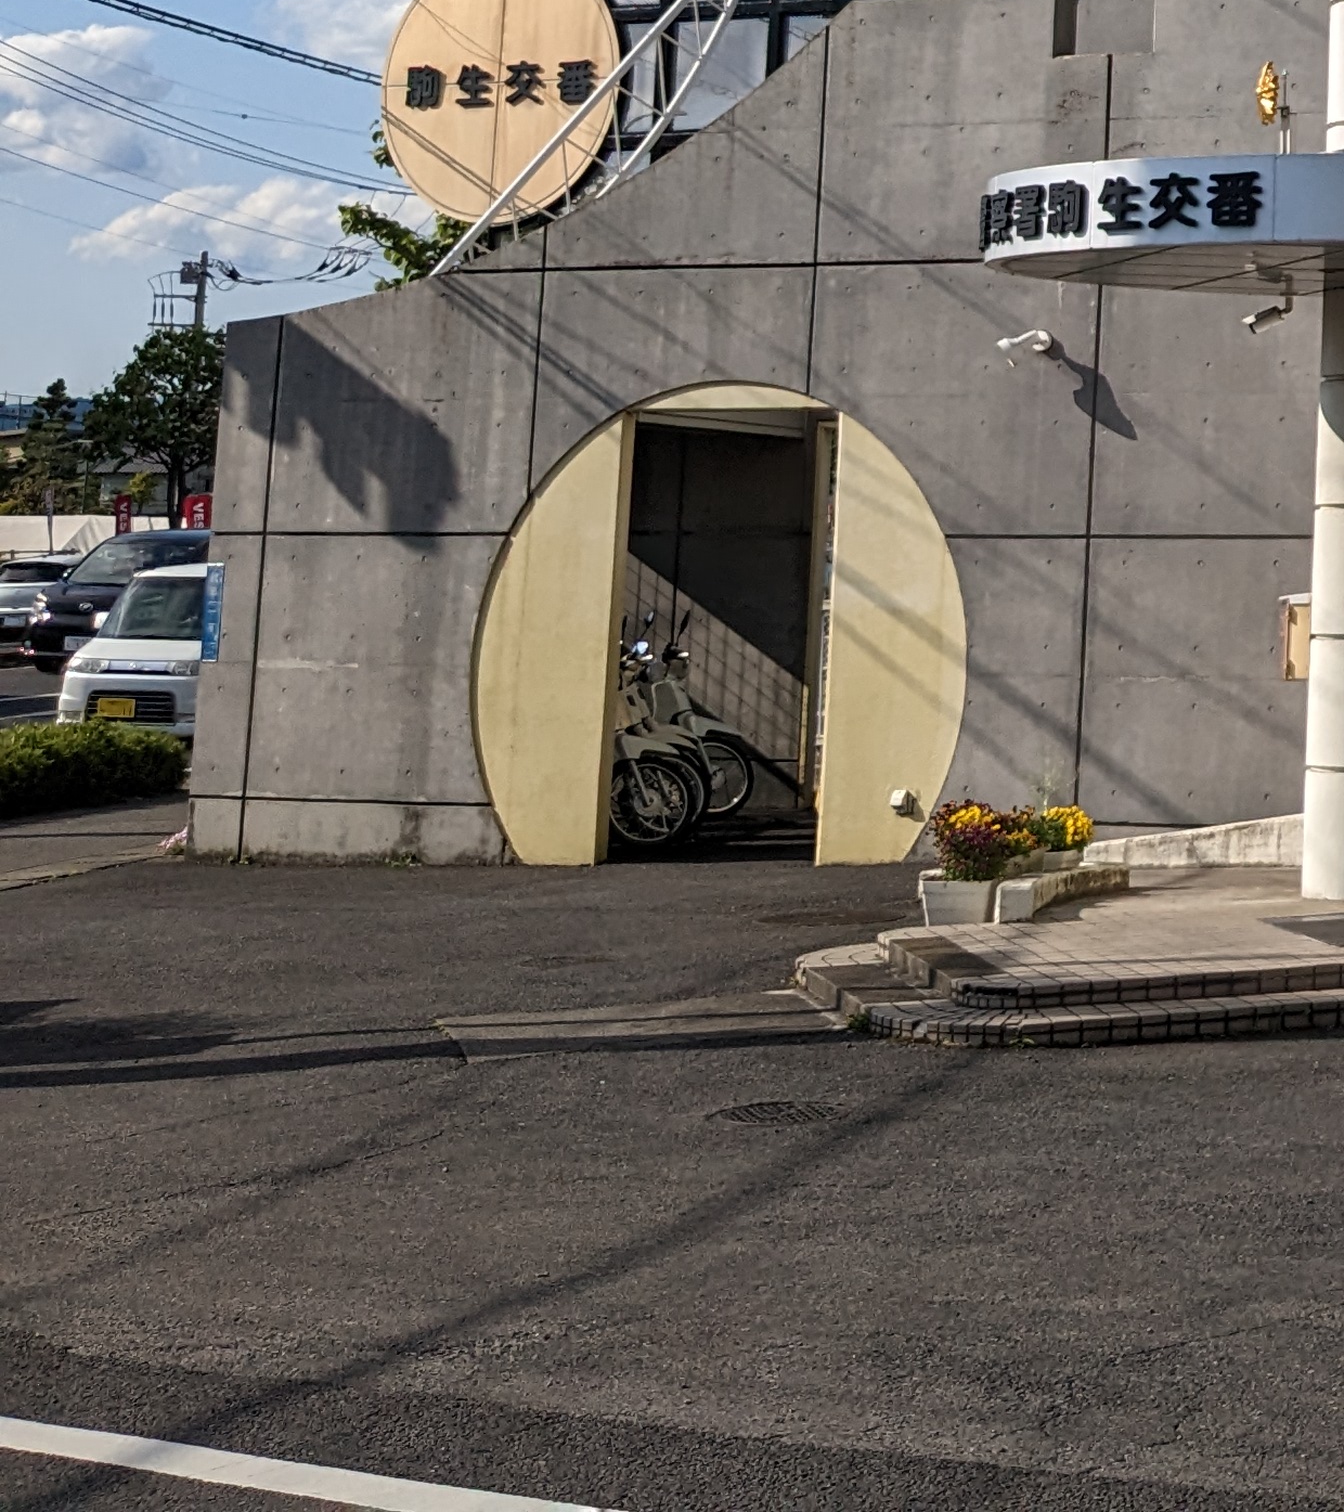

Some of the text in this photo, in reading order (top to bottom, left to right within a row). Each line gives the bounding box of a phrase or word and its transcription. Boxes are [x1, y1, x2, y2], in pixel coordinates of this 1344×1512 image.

[405, 59, 598, 110] 駒生交番
[979, 171, 1263, 252] 察署駒生交番
